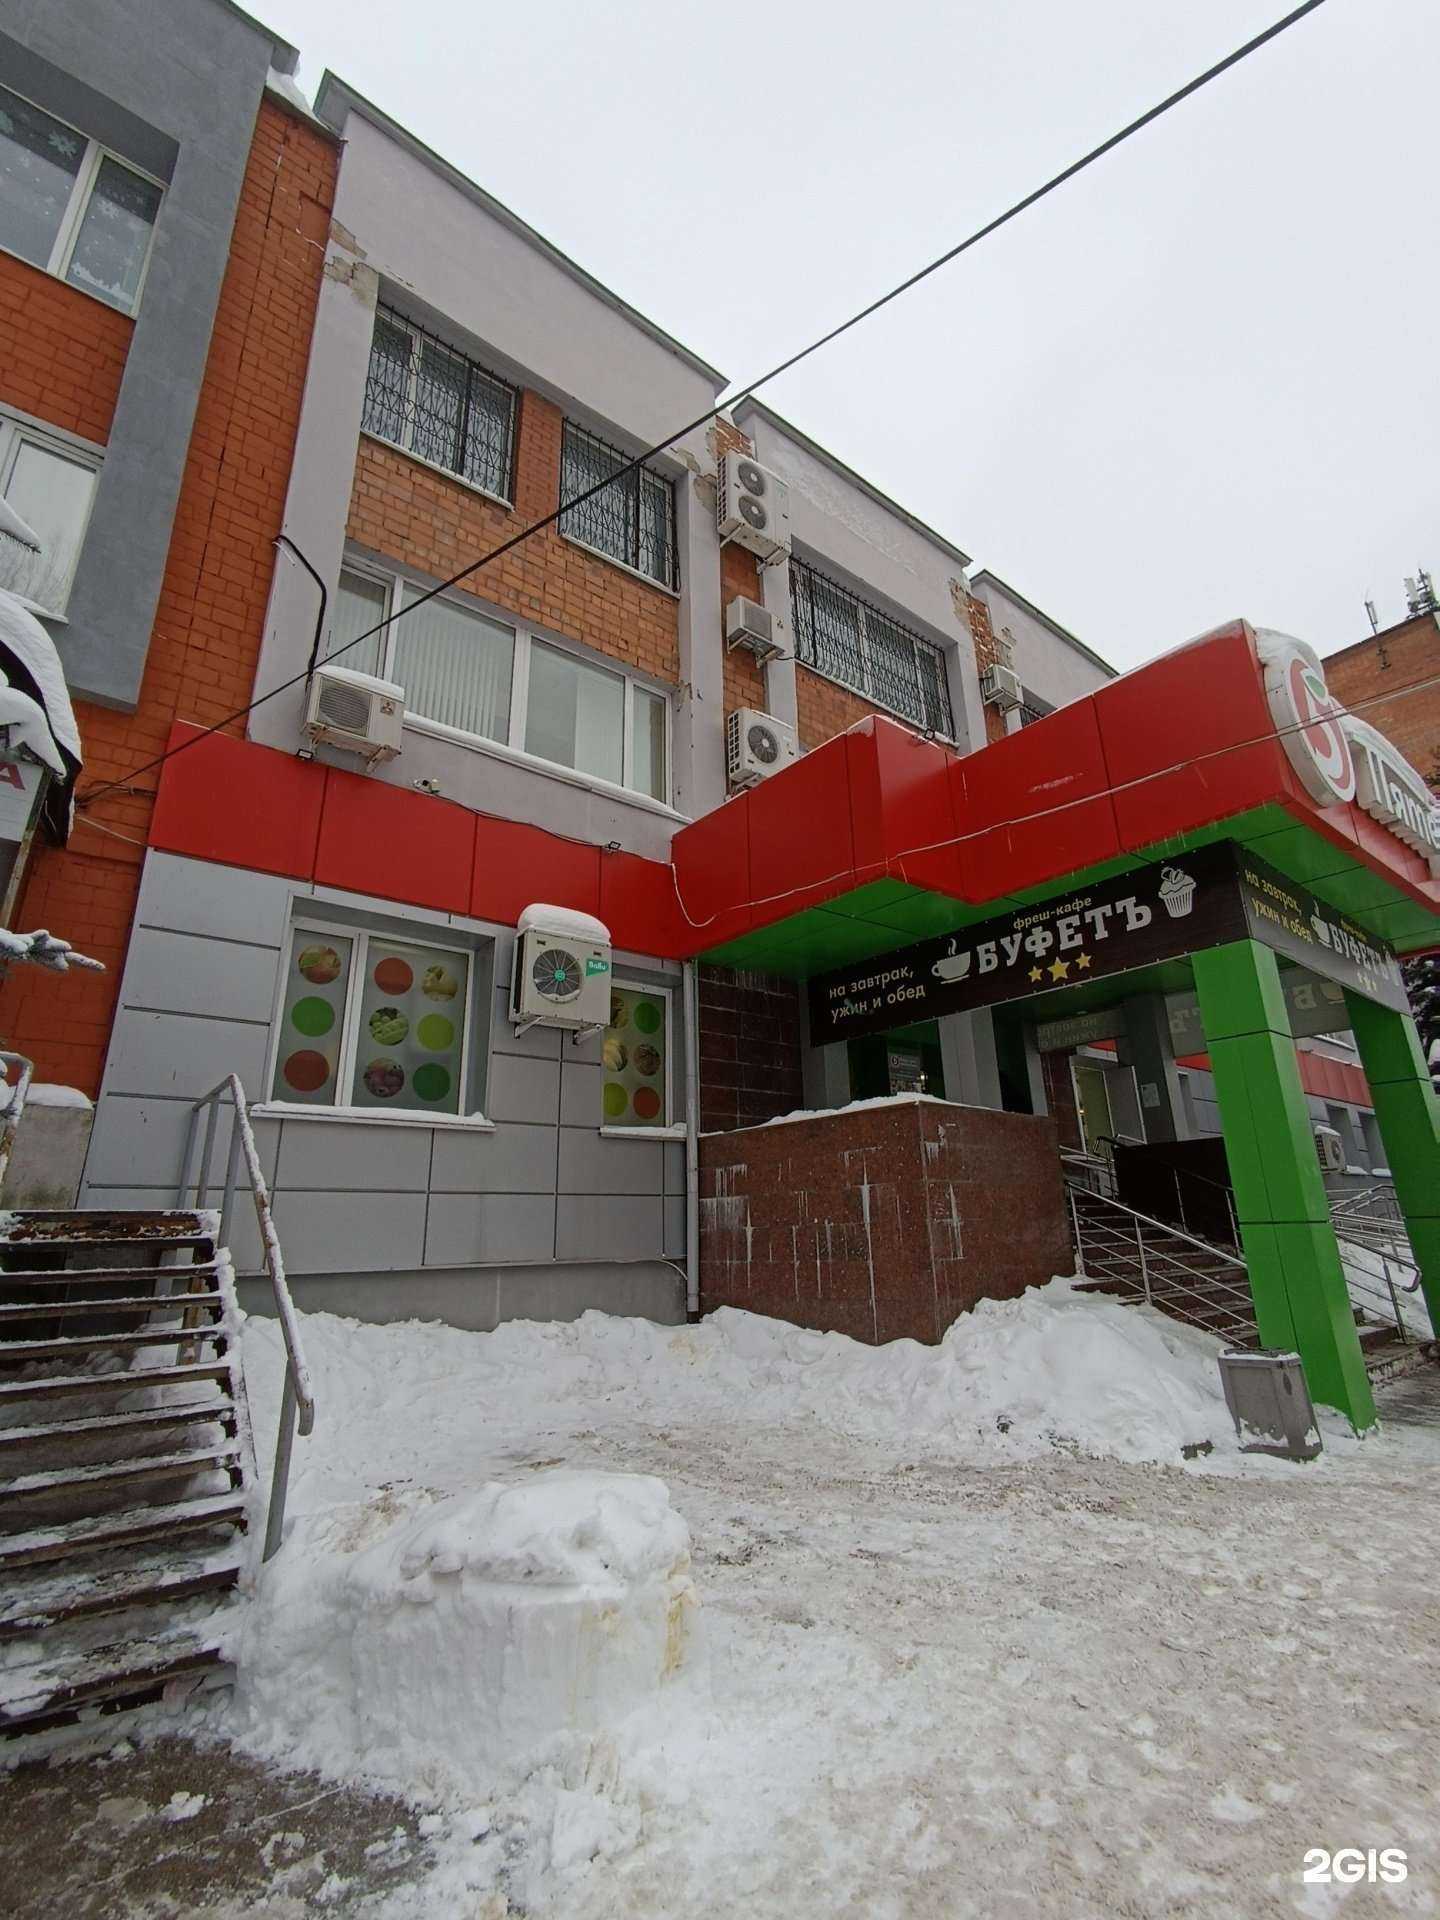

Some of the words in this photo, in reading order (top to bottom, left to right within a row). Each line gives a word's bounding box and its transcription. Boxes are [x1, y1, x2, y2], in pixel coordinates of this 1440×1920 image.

[1244, 869, 1260, 889] на
[1013, 897, 1093, 931] фреш-кафе
[976, 896, 1152, 974] БУФЕТЪ
[829, 985, 846, 1000] на
[850, 966, 914, 989] завтрак,
[831, 1000, 868, 1024] ужин
[872, 997, 882, 1009] и
[887, 984, 926, 1004] обед
